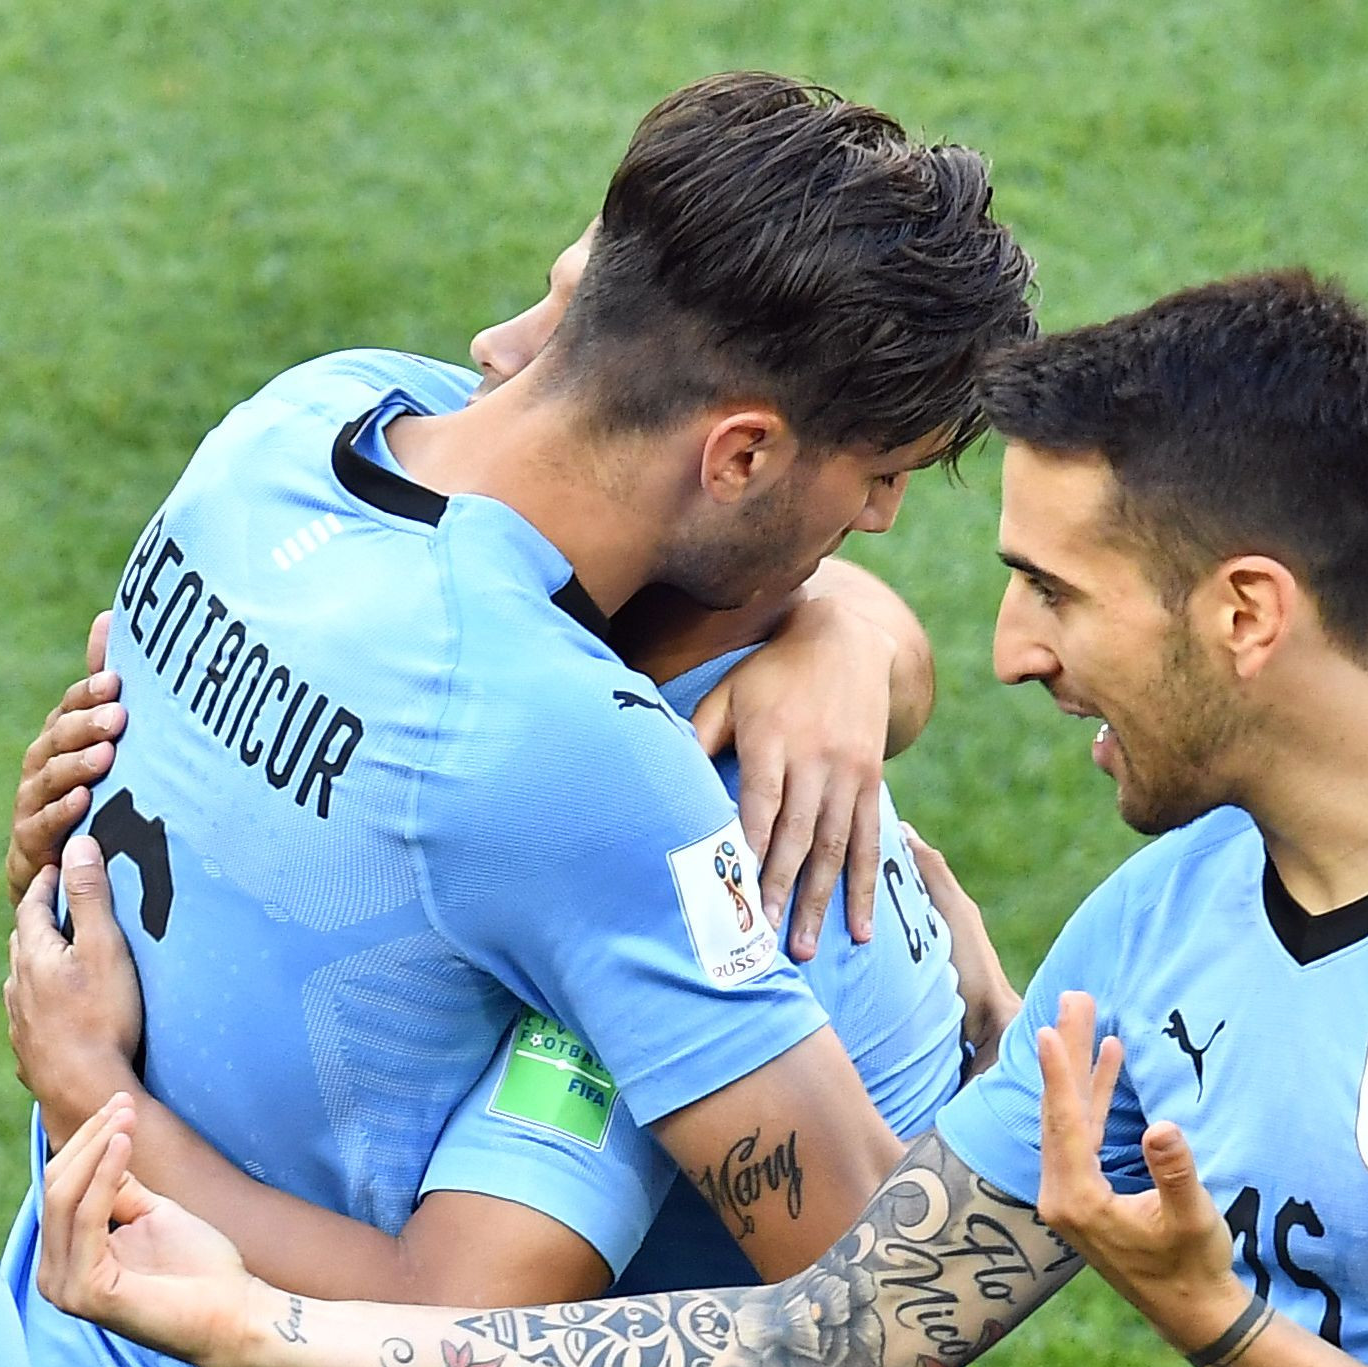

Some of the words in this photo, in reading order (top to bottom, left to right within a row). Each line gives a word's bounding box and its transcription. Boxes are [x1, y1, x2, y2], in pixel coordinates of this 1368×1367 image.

[120, 513, 364, 819] BENTANCUR
[567, 1078, 606, 1108] FIFA
[937, 1212, 1037, 1305] Flo
